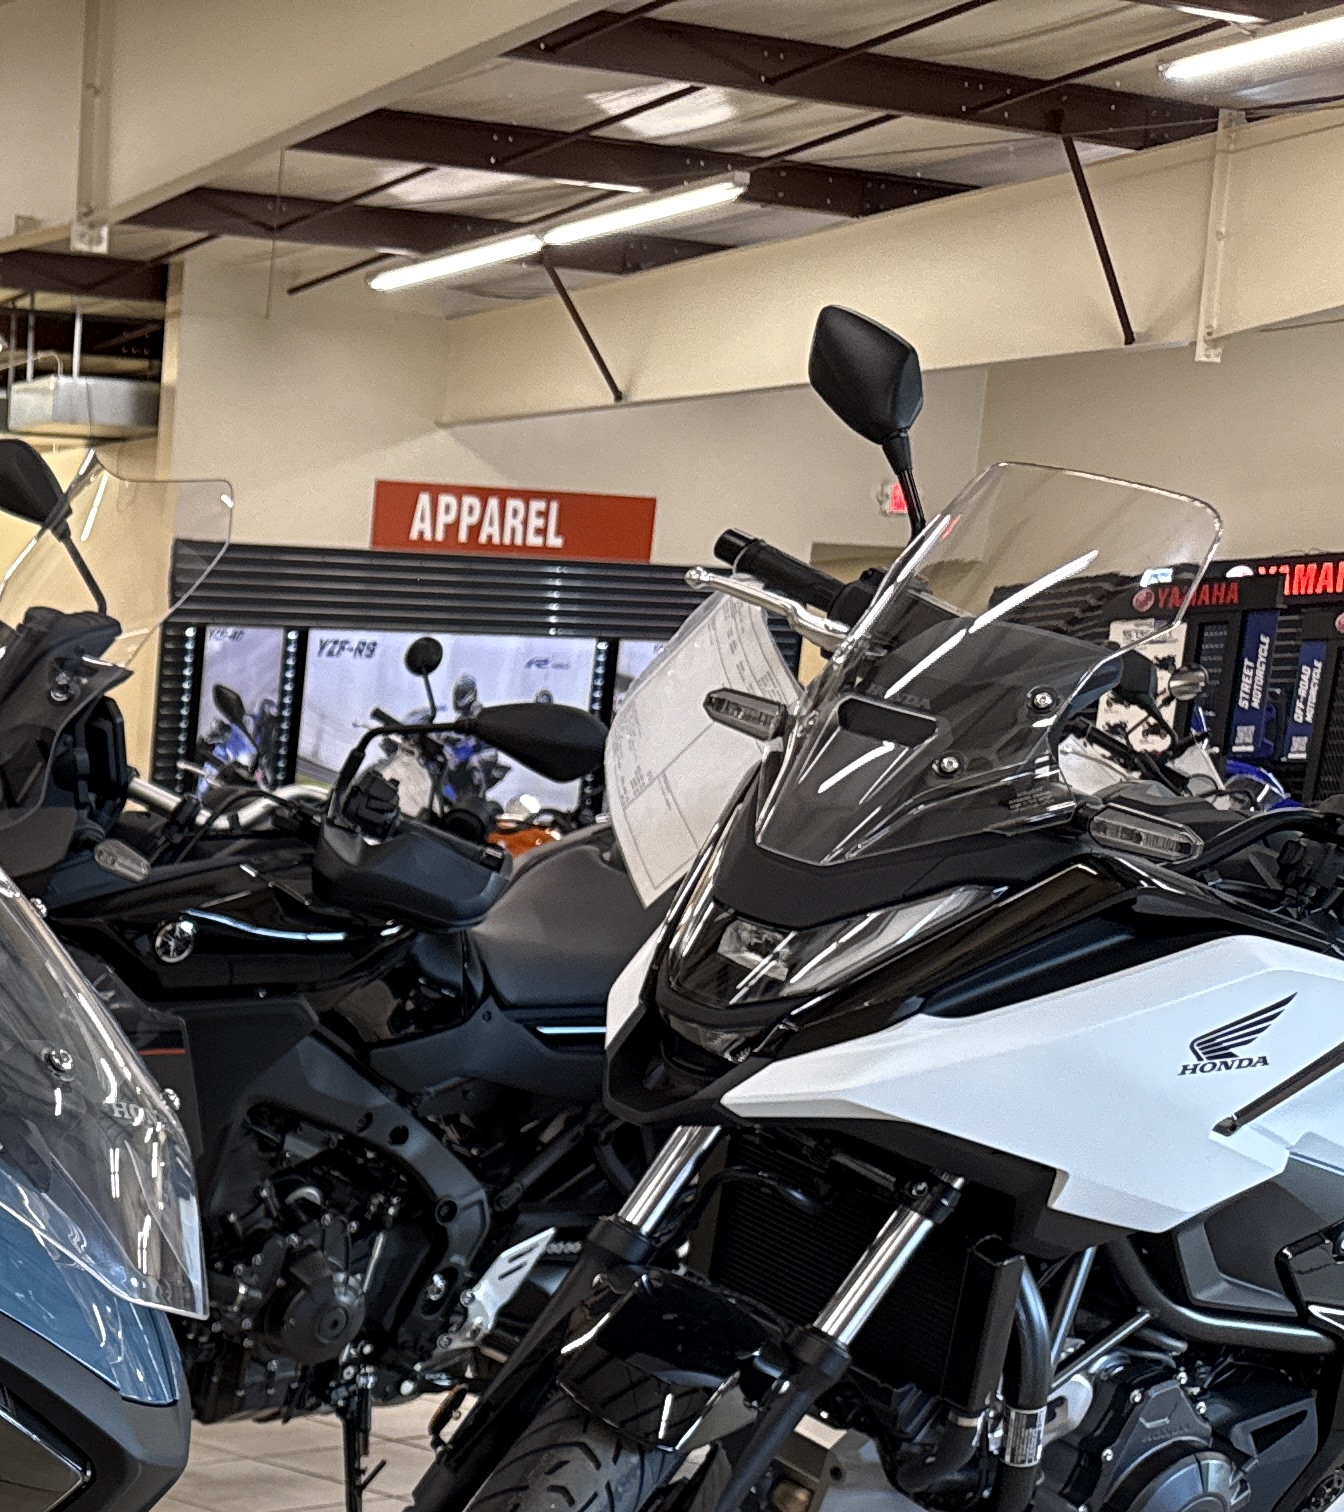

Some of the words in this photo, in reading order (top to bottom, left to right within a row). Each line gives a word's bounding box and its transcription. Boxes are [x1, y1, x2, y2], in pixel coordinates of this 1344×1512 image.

[409, 490, 565, 549] APPAREL
[1238, 657, 1255, 710] STREET
[1251, 633, 1270, 710] MOTORCYCLE
[1177, 1055, 1270, 1077] HONDA
